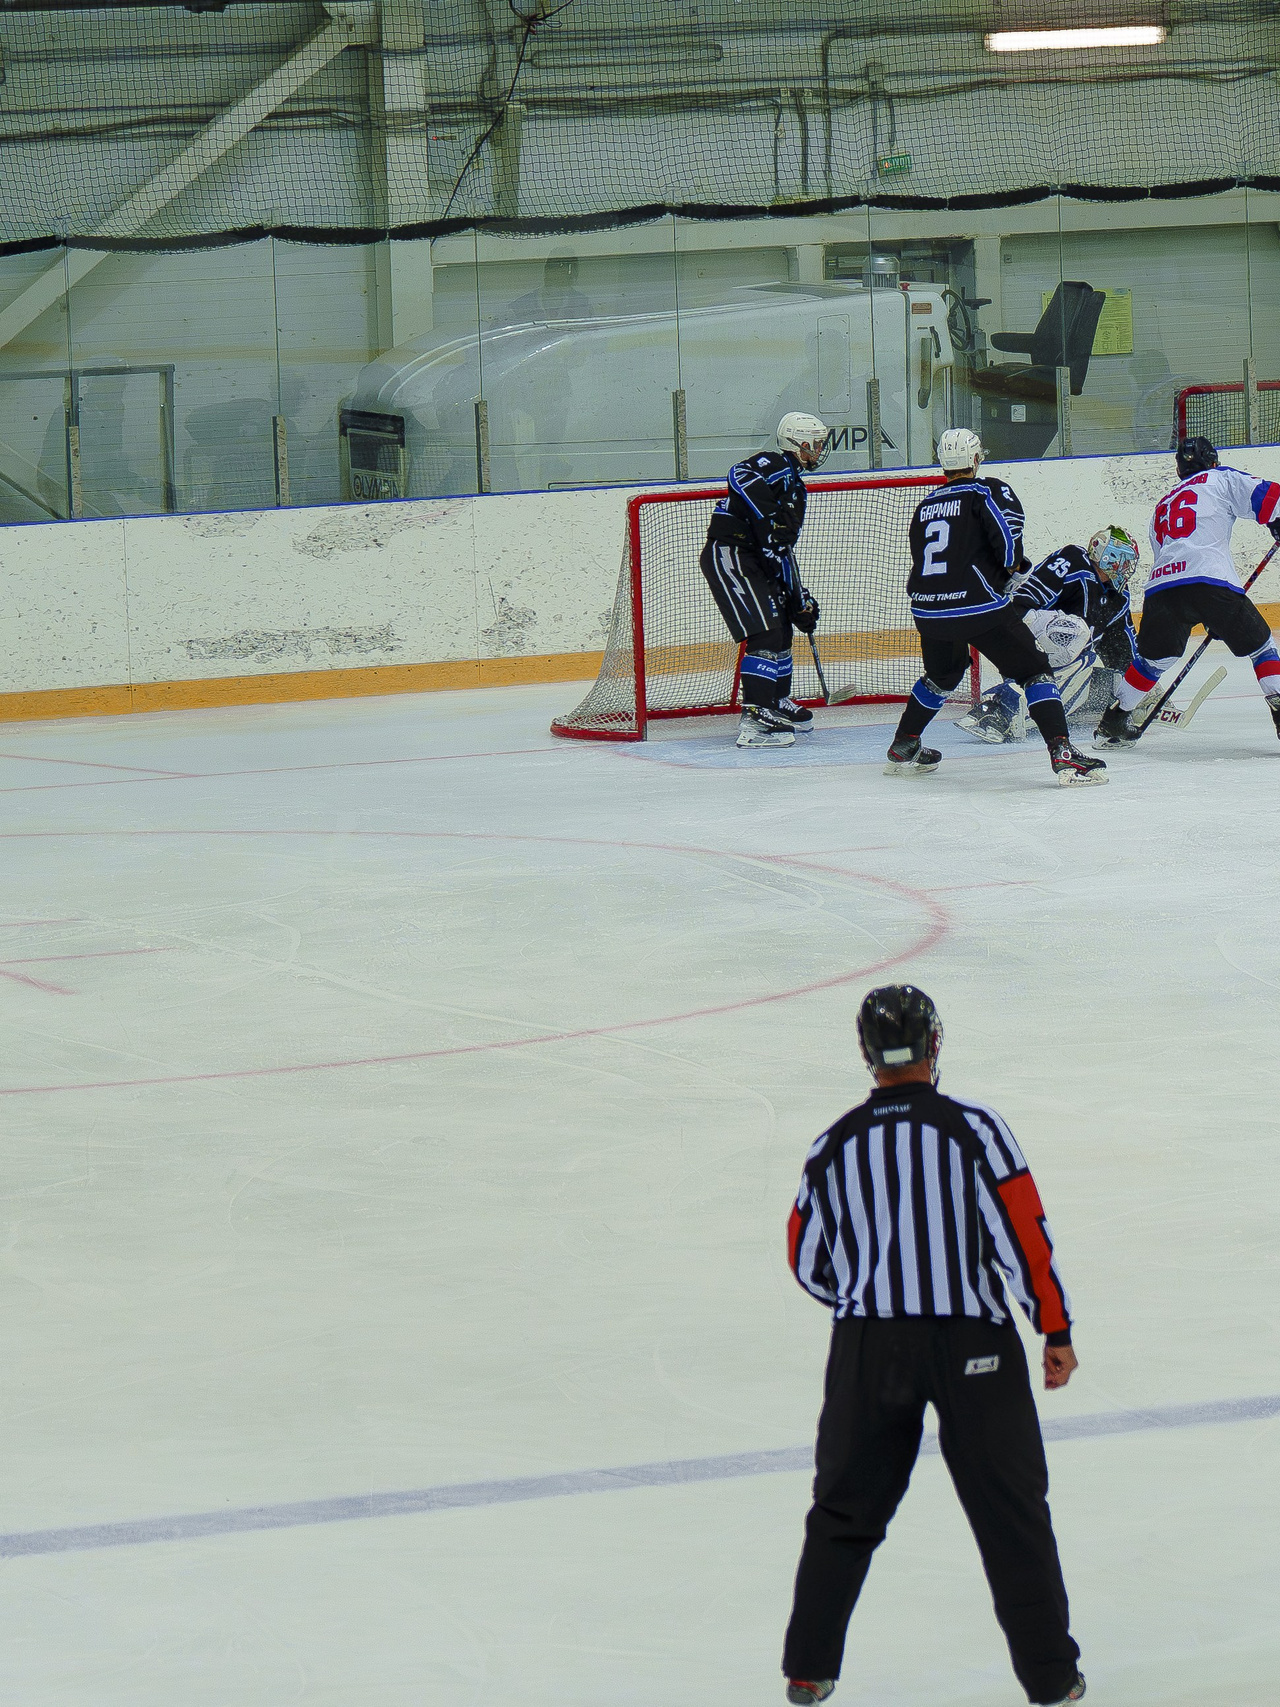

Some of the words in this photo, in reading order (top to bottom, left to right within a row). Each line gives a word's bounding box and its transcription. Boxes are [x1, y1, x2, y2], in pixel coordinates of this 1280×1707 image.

[919, 499, 962, 523] БАРМИН
[921, 520, 950, 576] 2
[1047, 557, 1071, 578] 35
[919, 592, 936, 602] ONE
[936, 591, 968, 600] TIMER
